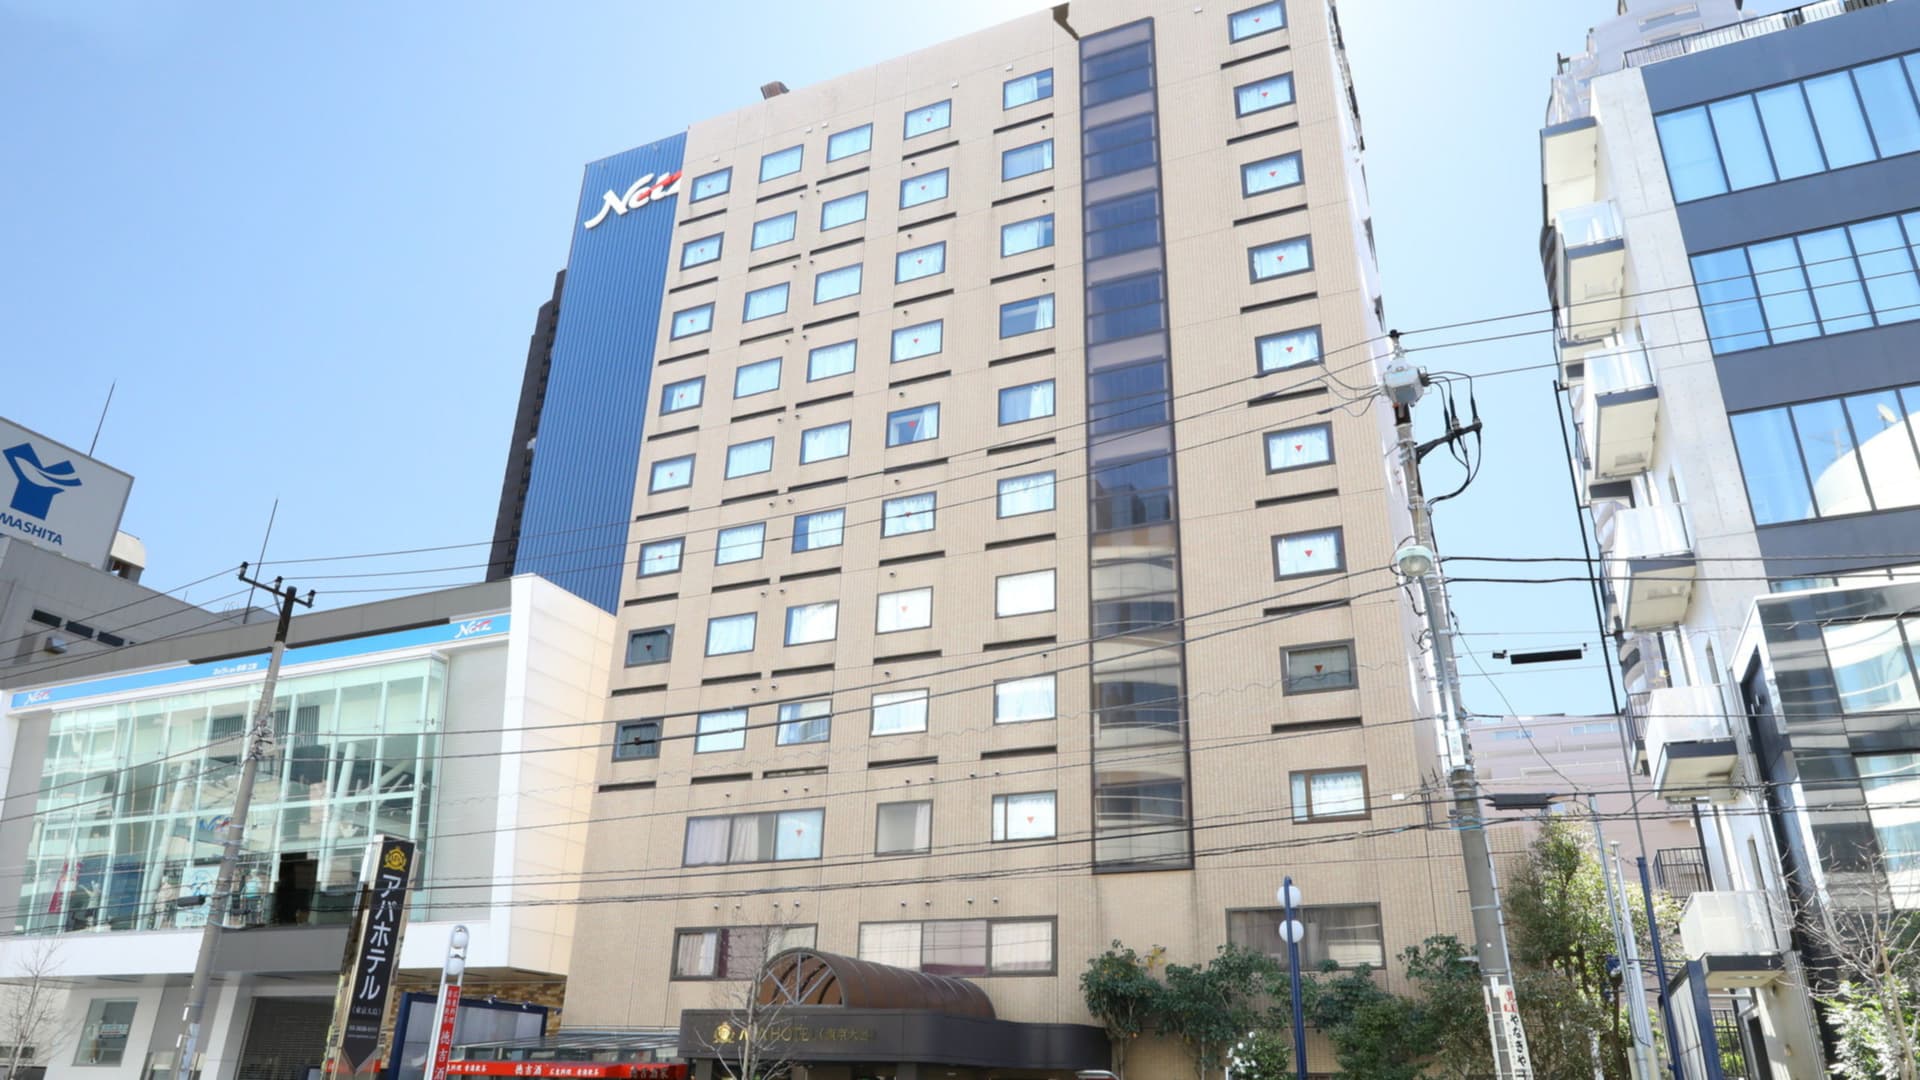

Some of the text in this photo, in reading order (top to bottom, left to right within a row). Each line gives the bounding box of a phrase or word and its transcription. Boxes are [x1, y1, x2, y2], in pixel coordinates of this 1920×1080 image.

[359, 874, 402, 1000] アパホテル
